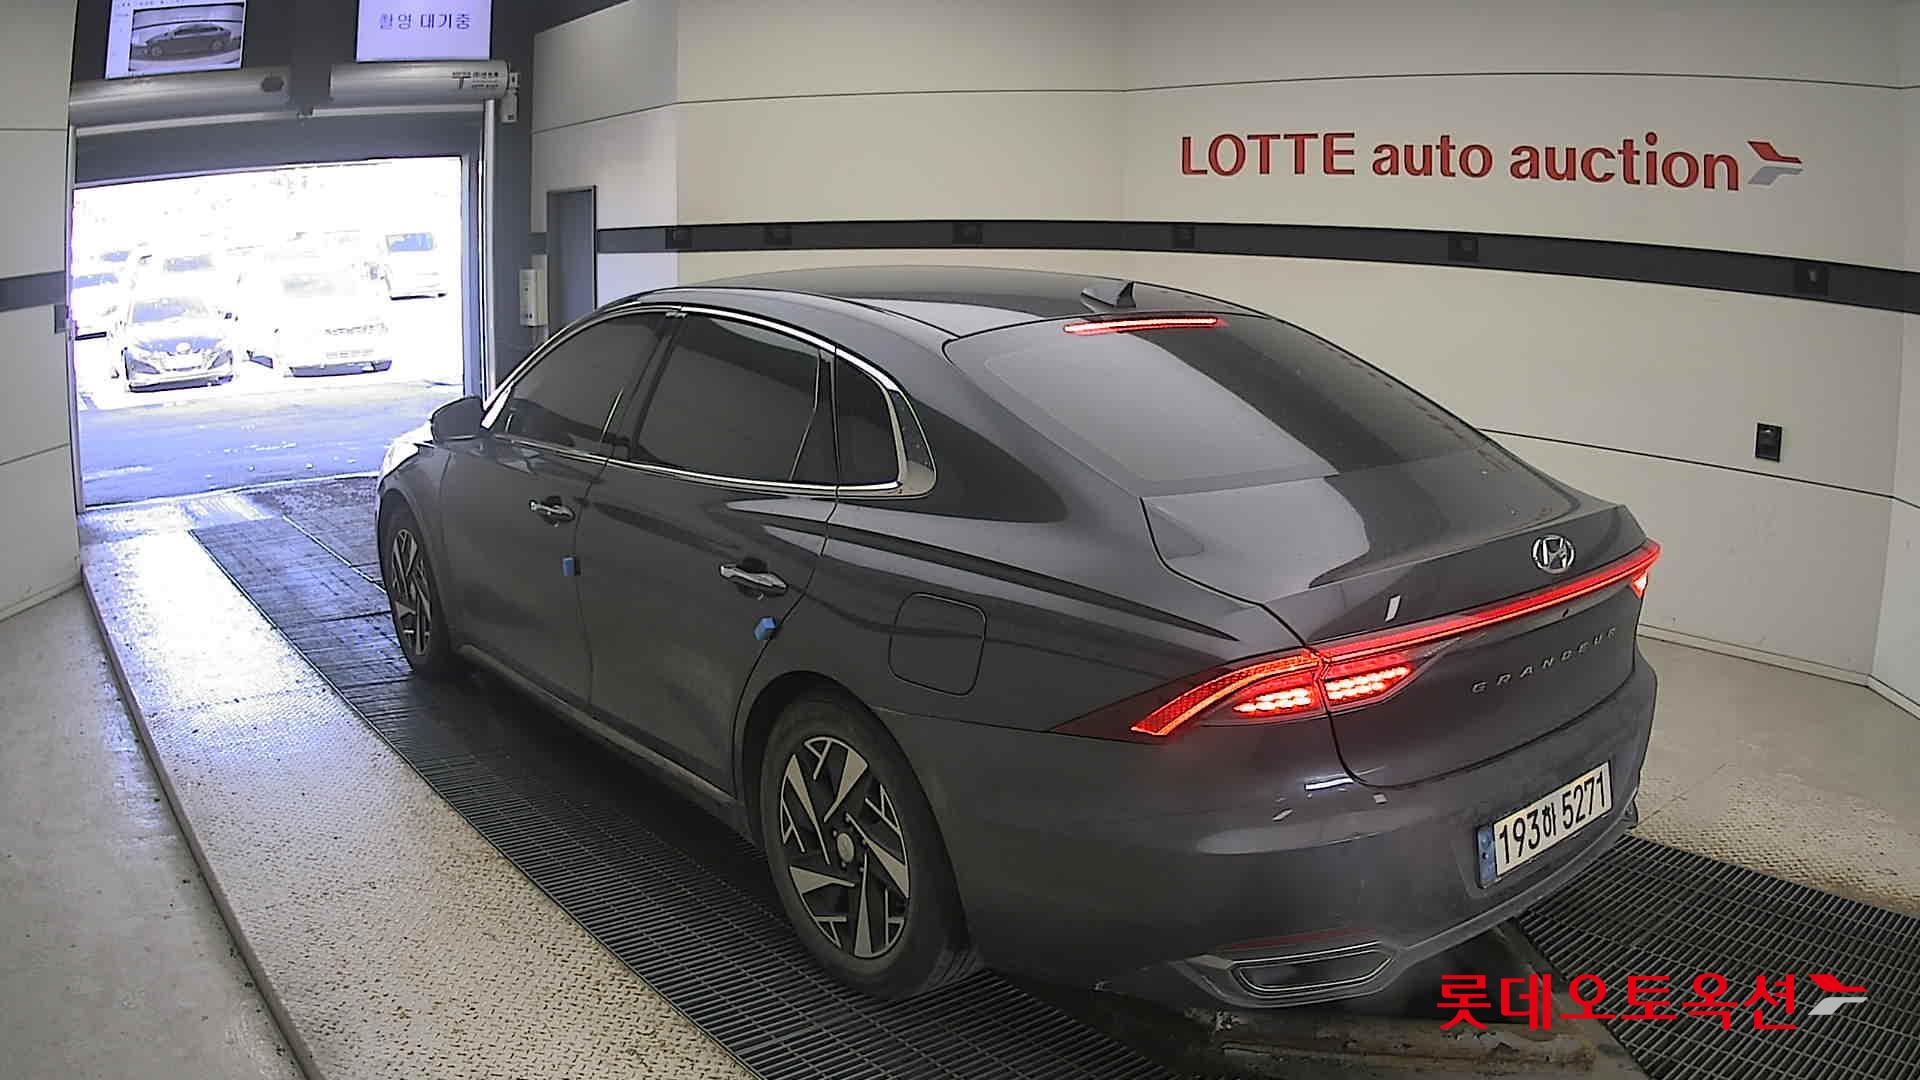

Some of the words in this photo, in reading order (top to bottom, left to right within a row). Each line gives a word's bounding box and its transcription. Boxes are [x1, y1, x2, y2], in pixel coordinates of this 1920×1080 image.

[420, 13, 472, 30] 대기중
[1181, 132, 1356, 176] LOTTE
[1372, 134, 1493, 178] auto
[1510, 132, 1740, 191] auction
[1472, 627, 1616, 693] GRANDEUR
[1562, 770, 1605, 830] 5271
